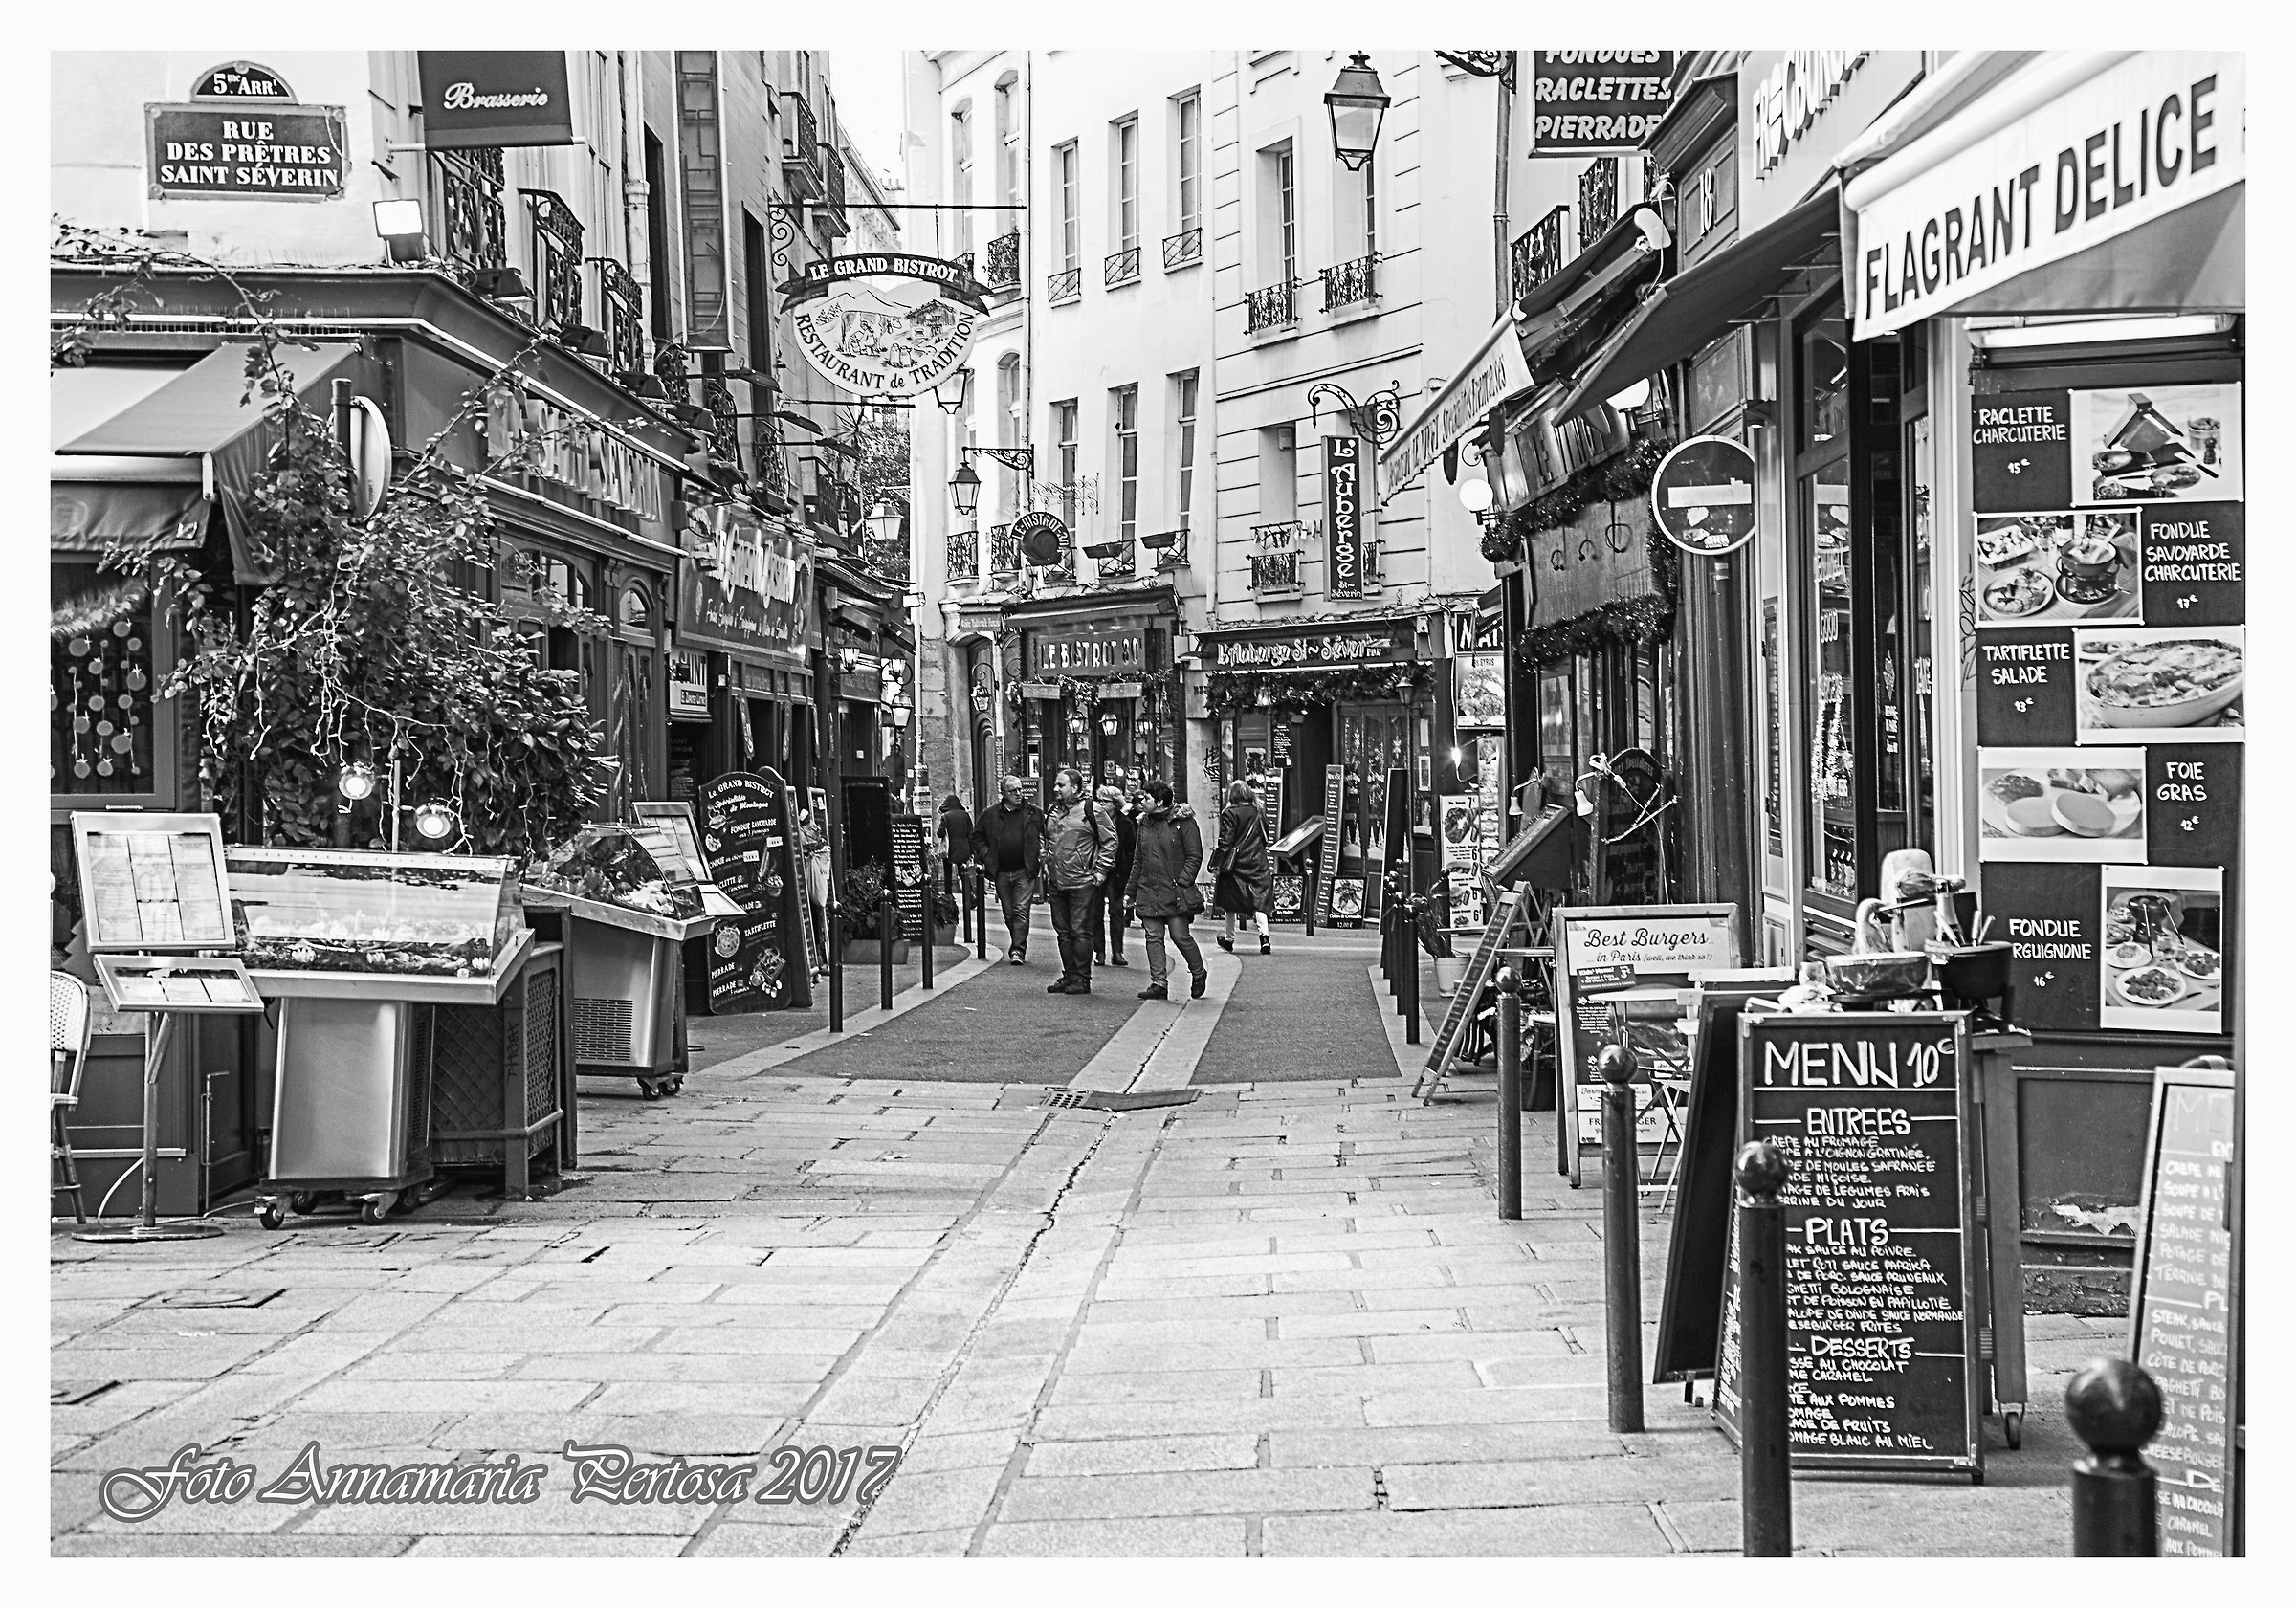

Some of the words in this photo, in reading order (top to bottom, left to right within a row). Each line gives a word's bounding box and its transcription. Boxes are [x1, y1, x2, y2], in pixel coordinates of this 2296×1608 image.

[443, 82, 548, 110] Brasserie
[1535, 76, 1673, 101] RACLETTES
[223, 121, 274, 140] RUE
[166, 142, 214, 162] DES
[221, 140, 332, 164] PRÊTRES
[161, 165, 229, 185] SAINT
[236, 162, 338, 187] SÉVERIN
[1699, 167, 1714, 237] 18
[1866, 163, 2041, 321] FLAGRANT
[2055, 73, 2218, 234] DELICE
[809, 265, 829, 281] LE
[833, 256, 889, 276] GRAND
[893, 257, 959, 284] BISTROT
[794, 312, 885, 389] RESTAURANT
[889, 372, 906, 389] de
[908, 311, 977, 385] TRADITION
[1979, 406, 2054, 426] RACLETTE
[1973, 425, 2066, 445] CHARCUTERIE
[1330, 438, 1357, 580] L'Auberge
[2146, 542, 2232, 562] SAVOYARDE
[2144, 562, 2242, 582] CHARCUTERIE
[1041, 644, 1056, 669] LE
[1060, 640, 1116, 670] BISTROT
[1982, 643, 2071, 662] TARTIFLETTE
[1991, 666, 2048, 686] SALADE
[2166, 761, 2205, 781] FOIE
[718, 779, 743, 793] GRAND
[2156, 783, 2208, 802] GRAS
[709, 856, 725, 870] ONDUE
[2009, 918, 2082, 938] FONDUE
[1584, 928, 1627, 948] Best
[1610, 950, 1641, 962] Paris
[2012, 942, 2092, 960] RGUIGNONE
[1807, 1107, 1912, 1136] ENTREES
[1803, 1136, 1820, 1148] AU
[1821, 1136, 1880, 1149] FROMAGE
[1806, 1161, 1821, 1172] DE
[1823, 1161, 1869, 1173] MOULES
[2164, 1159, 2203, 1178] CREPE
[1815, 1184, 1831, 1196] DE
[1834, 1185, 1891, 1198] LEGUMES
[2163, 1179, 2200, 1199] SOUPE
[1827, 1197, 1845, 1208] DU
[1852, 1198, 1887, 1209] JOUR
[2161, 1202, 2197, 1220] SOUPE
[2200, 1206, 2216, 1221] DE
[1805, 1217, 1890, 1246] PLATS
[2159, 1223, 2204, 1244] SALADE
[1805, 1245, 1847, 1256] SAUCE
[1850, 1246, 1867, 1257] AU
[2159, 1245, 2207, 1264] POTAGE
[2211, 1252, 2228, 1267] DE
[1842, 1260, 1880, 1271] SAUCE
[2154, 1262, 2207, 1288] TERRINE
[1797, 1270, 1813, 1281] DE
[1850, 1271, 1884, 1283] SAUCE
[1886, 1272, 1948, 1286] PRUNEAUX
[1803, 1295, 1819, 1306] DE
[1869, 1296, 1885, 1308] EN
[1787, 1308, 1825, 1320] ALOPE
[1827, 1309, 1843, 1320] DE
[1881, 1311, 1911, 1321] SAUCE
[1912, 1311, 1964, 1324] NORMANDE
[1788, 1319, 1855, 1332] ESEBURGER
[1811, 1335, 1916, 1360] DESSERTS
[1819, 1359, 1837, 1371] AU
[1842, 1359, 1910, 1374] CHOCOLAT
[2180, 1359, 2197, 1374] DE
[1812, 1370, 1874, 1383] CARAMEL
[1809, 1395, 1834, 1407] AUX
[1838, 1393, 1896, 1409] POMMES
[2180, 1403, 2197, 1419] DE
[1821, 1420, 1840, 1431] DE
[1829, 1434, 1872, 1447] BLANC
[1875, 1435, 1894, 1448] AU
